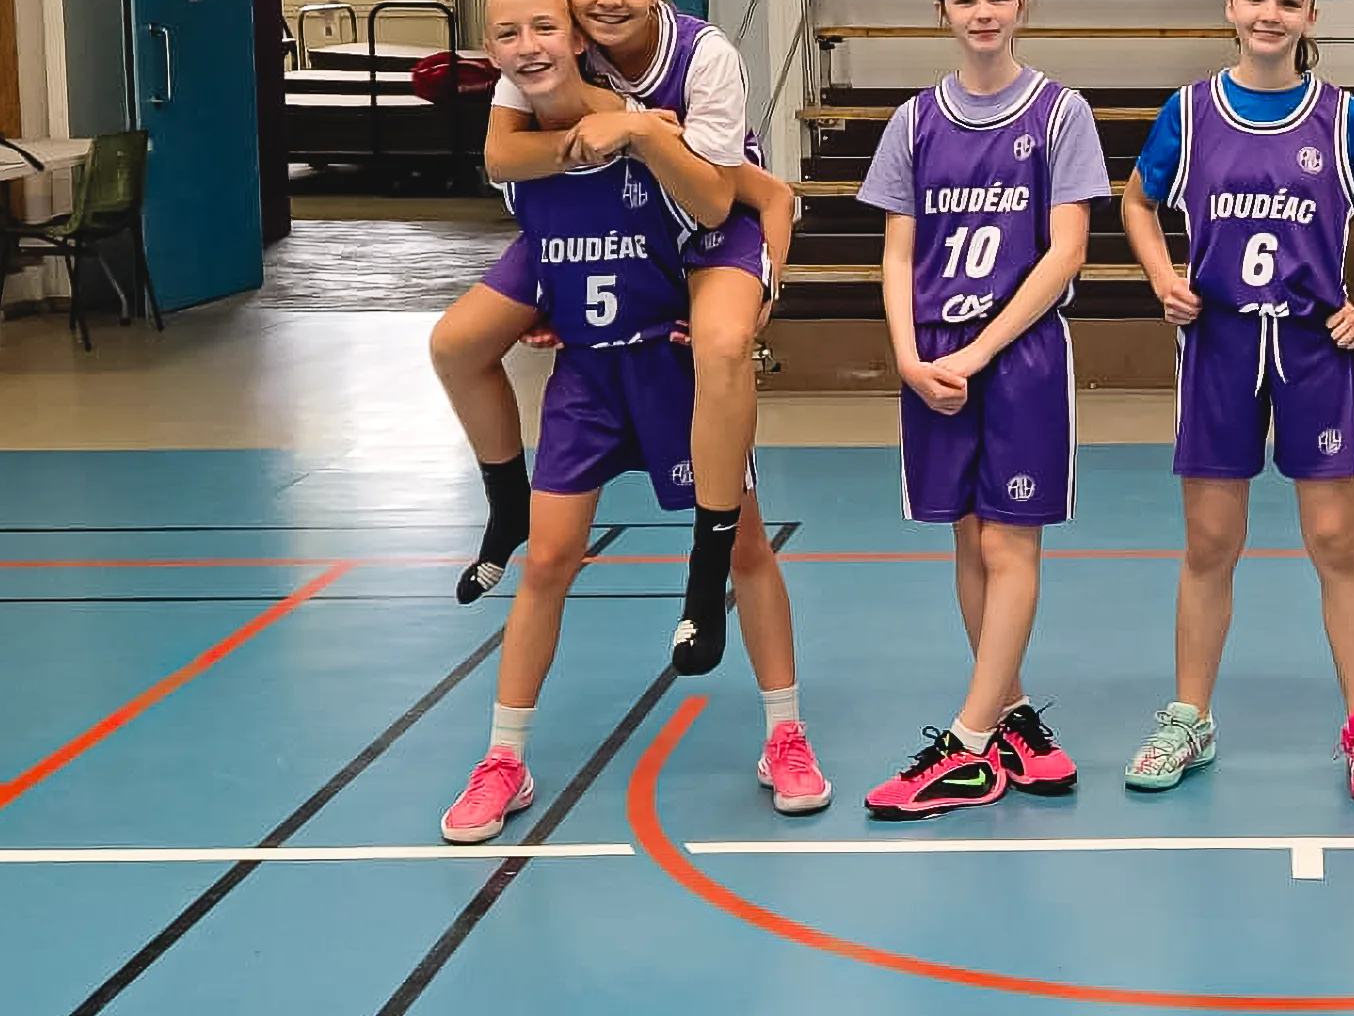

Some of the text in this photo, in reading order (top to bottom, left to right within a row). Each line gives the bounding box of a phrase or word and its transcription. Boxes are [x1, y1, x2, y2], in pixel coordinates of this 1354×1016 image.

[925, 182, 1030, 215] LOUDÉAC
[942, 225, 1001, 279] 10
[1242, 232, 1279, 287] 6
[585, 274, 618, 327] 5
